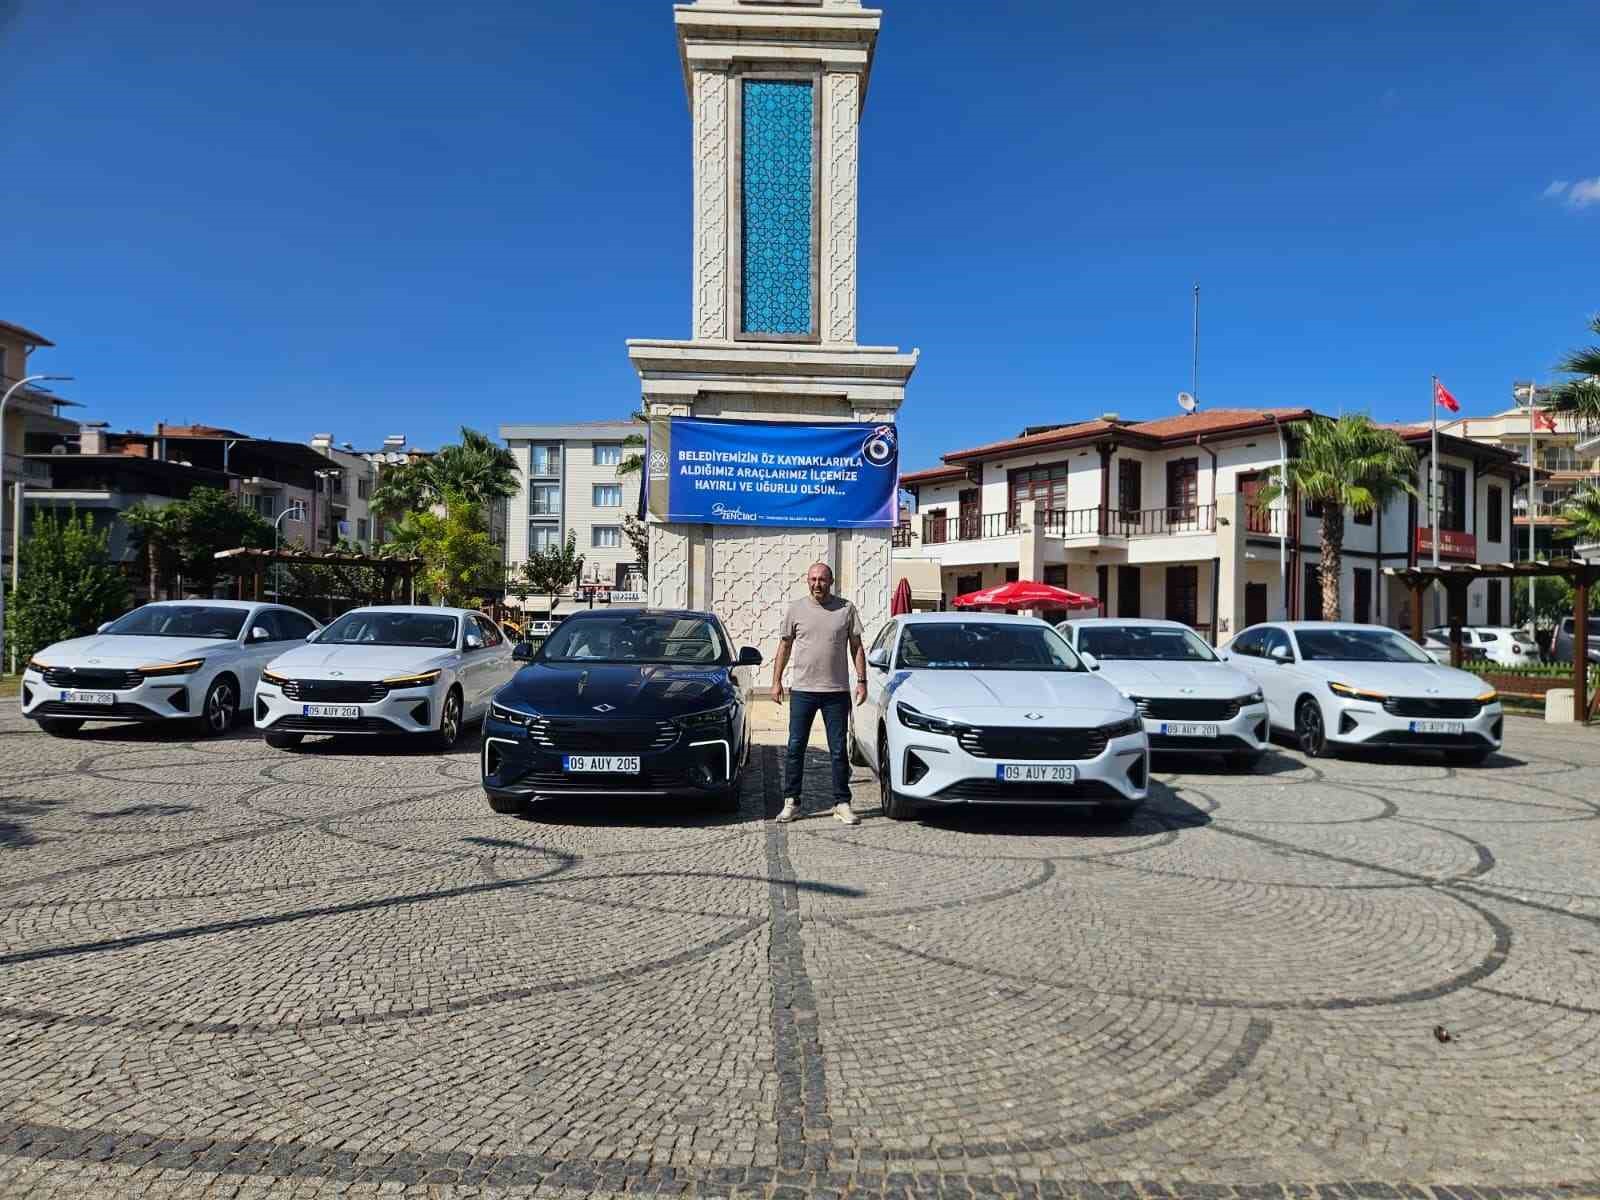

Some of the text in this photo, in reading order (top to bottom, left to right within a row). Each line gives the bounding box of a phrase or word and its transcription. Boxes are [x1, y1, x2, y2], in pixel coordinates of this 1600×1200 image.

[678, 449, 863, 467] BELEDİYEMİZİN ÖZ KAYNAKLARIYLA
[680, 464, 734, 476] ALDIĞIMIZ
[737, 467, 807, 480] ARAÇLARIMIZ
[810, 468, 857, 482] İLÇEMİZE
[695, 480, 846, 495] HAYIRLI VE UĞURLU OLSUN...
[310, 706, 357, 717] 09 AUY 204
[570, 757, 637, 770] 09 AUY 205
[1006, 766, 1072, 780] 09 AUY 203
